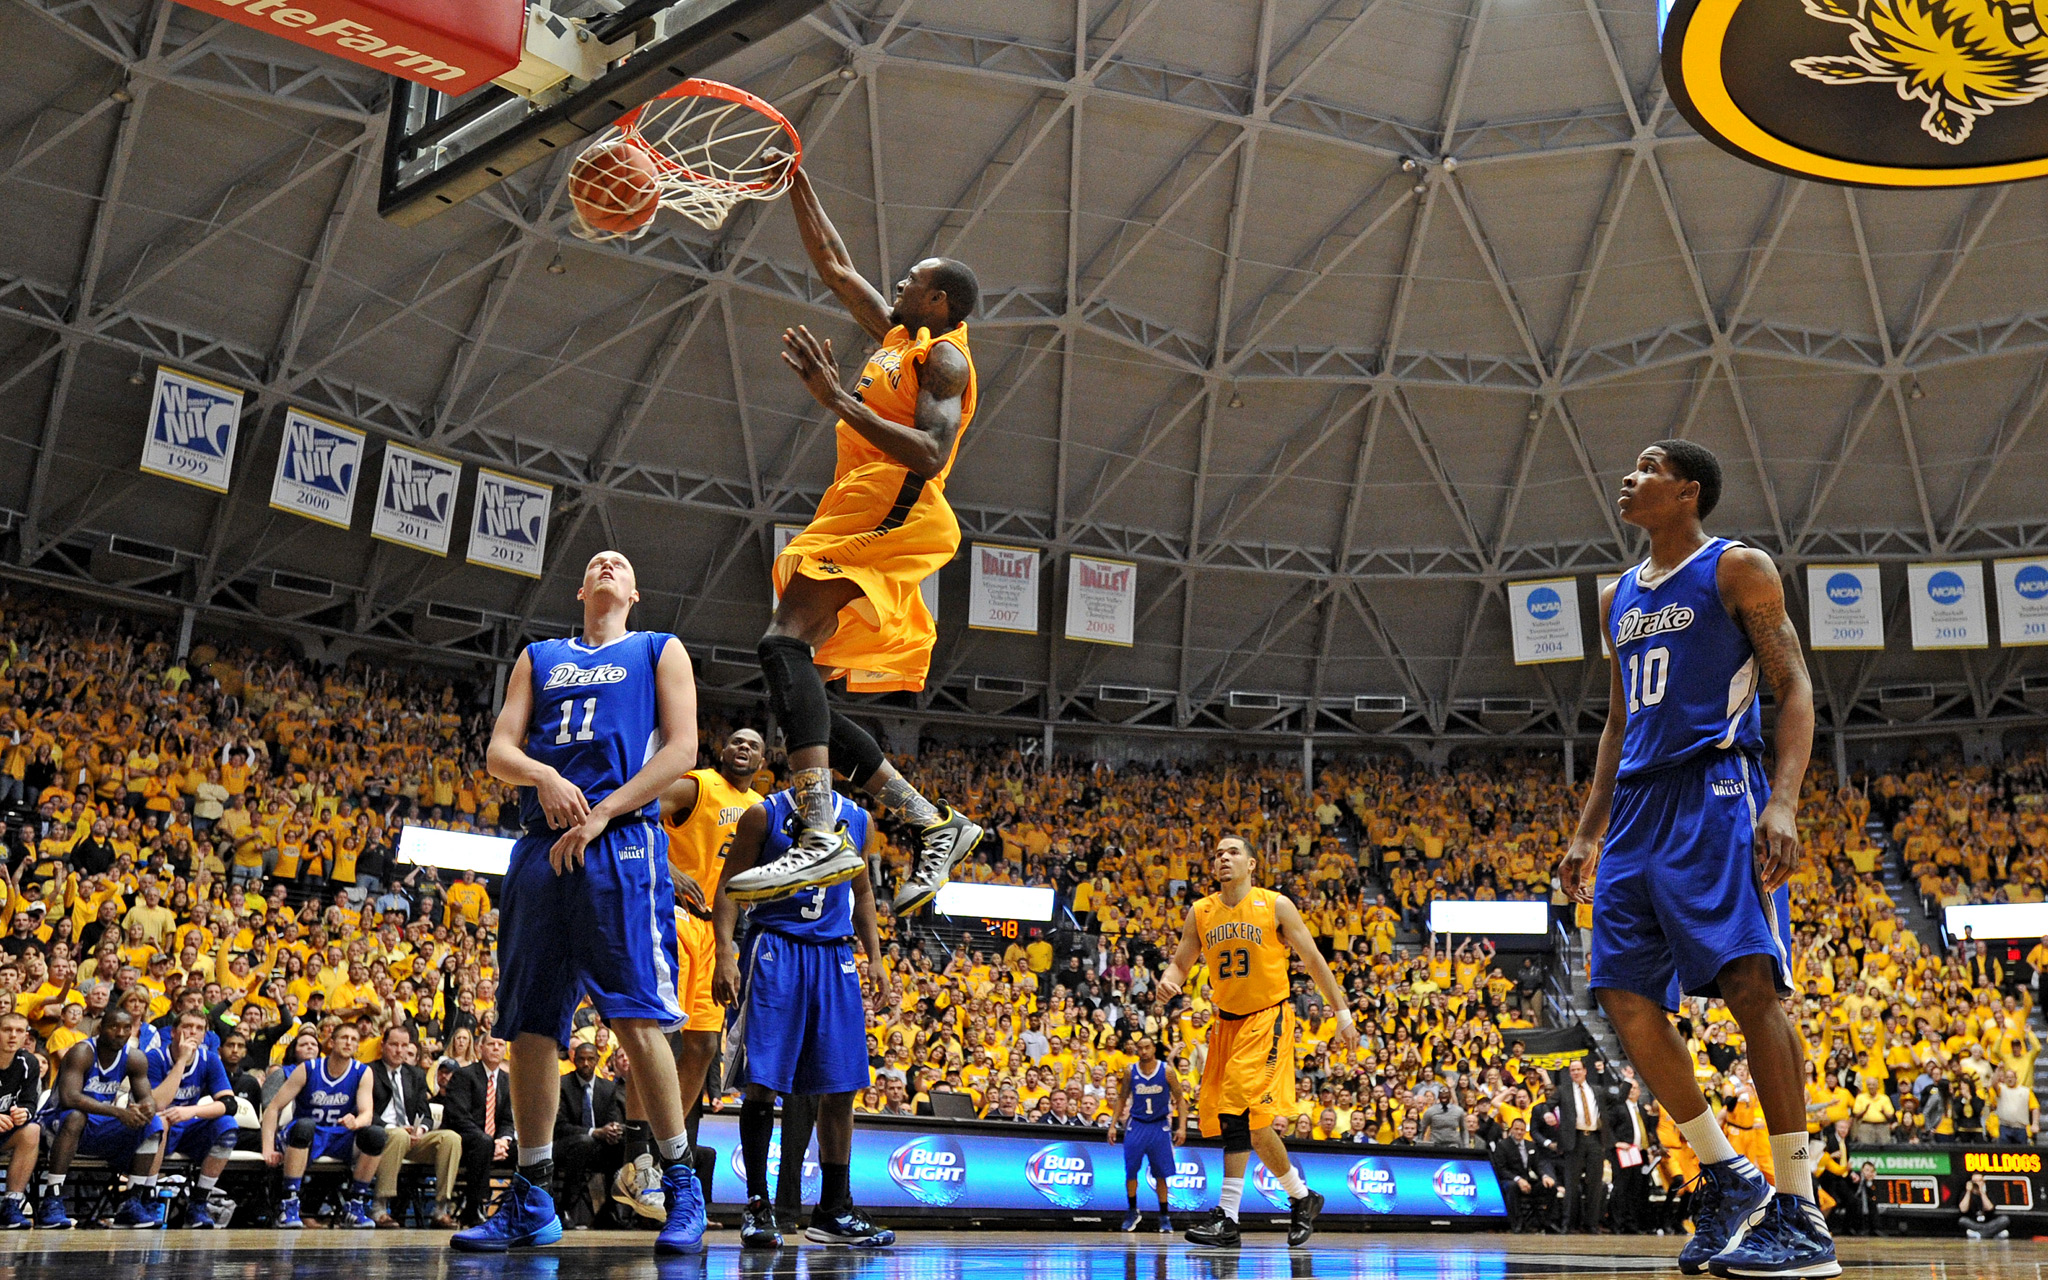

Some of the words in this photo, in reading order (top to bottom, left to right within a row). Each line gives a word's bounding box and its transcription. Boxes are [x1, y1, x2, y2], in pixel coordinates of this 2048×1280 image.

[168, 452, 208, 476] 1999
[297, 490, 329, 511] 2000
[396, 521, 429, 540] 2011
[491, 546, 524, 563] 2012
[981, 549, 1033, 579] VALLEY
[1080, 562, 1130, 592] VALLEY
[1830, 588, 1862, 598] NCAA
[1932, 587, 1965, 598] NCAA
[989, 608, 1019, 622] 2007
[1531, 602, 1562, 613] NCAA
[1086, 620, 1115, 634] 2008
[1616, 602, 1694, 648] Drake
[1935, 626, 1967, 639] 2010
[2024, 623, 2046, 635] 201
[1832, 628, 1864, 639] 2009
[1534, 642, 1562, 654] 2004
[543, 662, 627, 691] Drake
[1628, 646, 1670, 715] 10
[555, 697, 597, 745] 11
[1712, 781, 1746, 796] VALLEY
[619, 847, 645, 861] VALLEY
[800, 886, 827, 920] 3
[1205, 922, 1263, 950] SHOCKERS
[1218, 948, 1250, 980] 23
[310, 1090, 350, 1106] Drake
[1145, 1098, 1153, 1114] 1
[311, 1108, 341, 1127] 25
[909, 1149, 956, 1166] BUD
[1044, 1155, 1085, 1171] BUD
[1886, 1157, 1937, 1169] DENTAL
[1965, 1153, 2041, 1172] BULLDOGS
[902, 1163, 964, 1182] LIGHT
[1175, 1162, 1199, 1175] UD
[1359, 1168, 1389, 1181] BUD
[1037, 1169, 1092, 1186] LIGHT
[1167, 1176, 1206, 1189] IGHT
[1443, 1171, 1470, 1184] BUD
[1357, 1181, 1395, 1194] LIGHT
[1442, 1184, 1476, 1196] LIGHT
